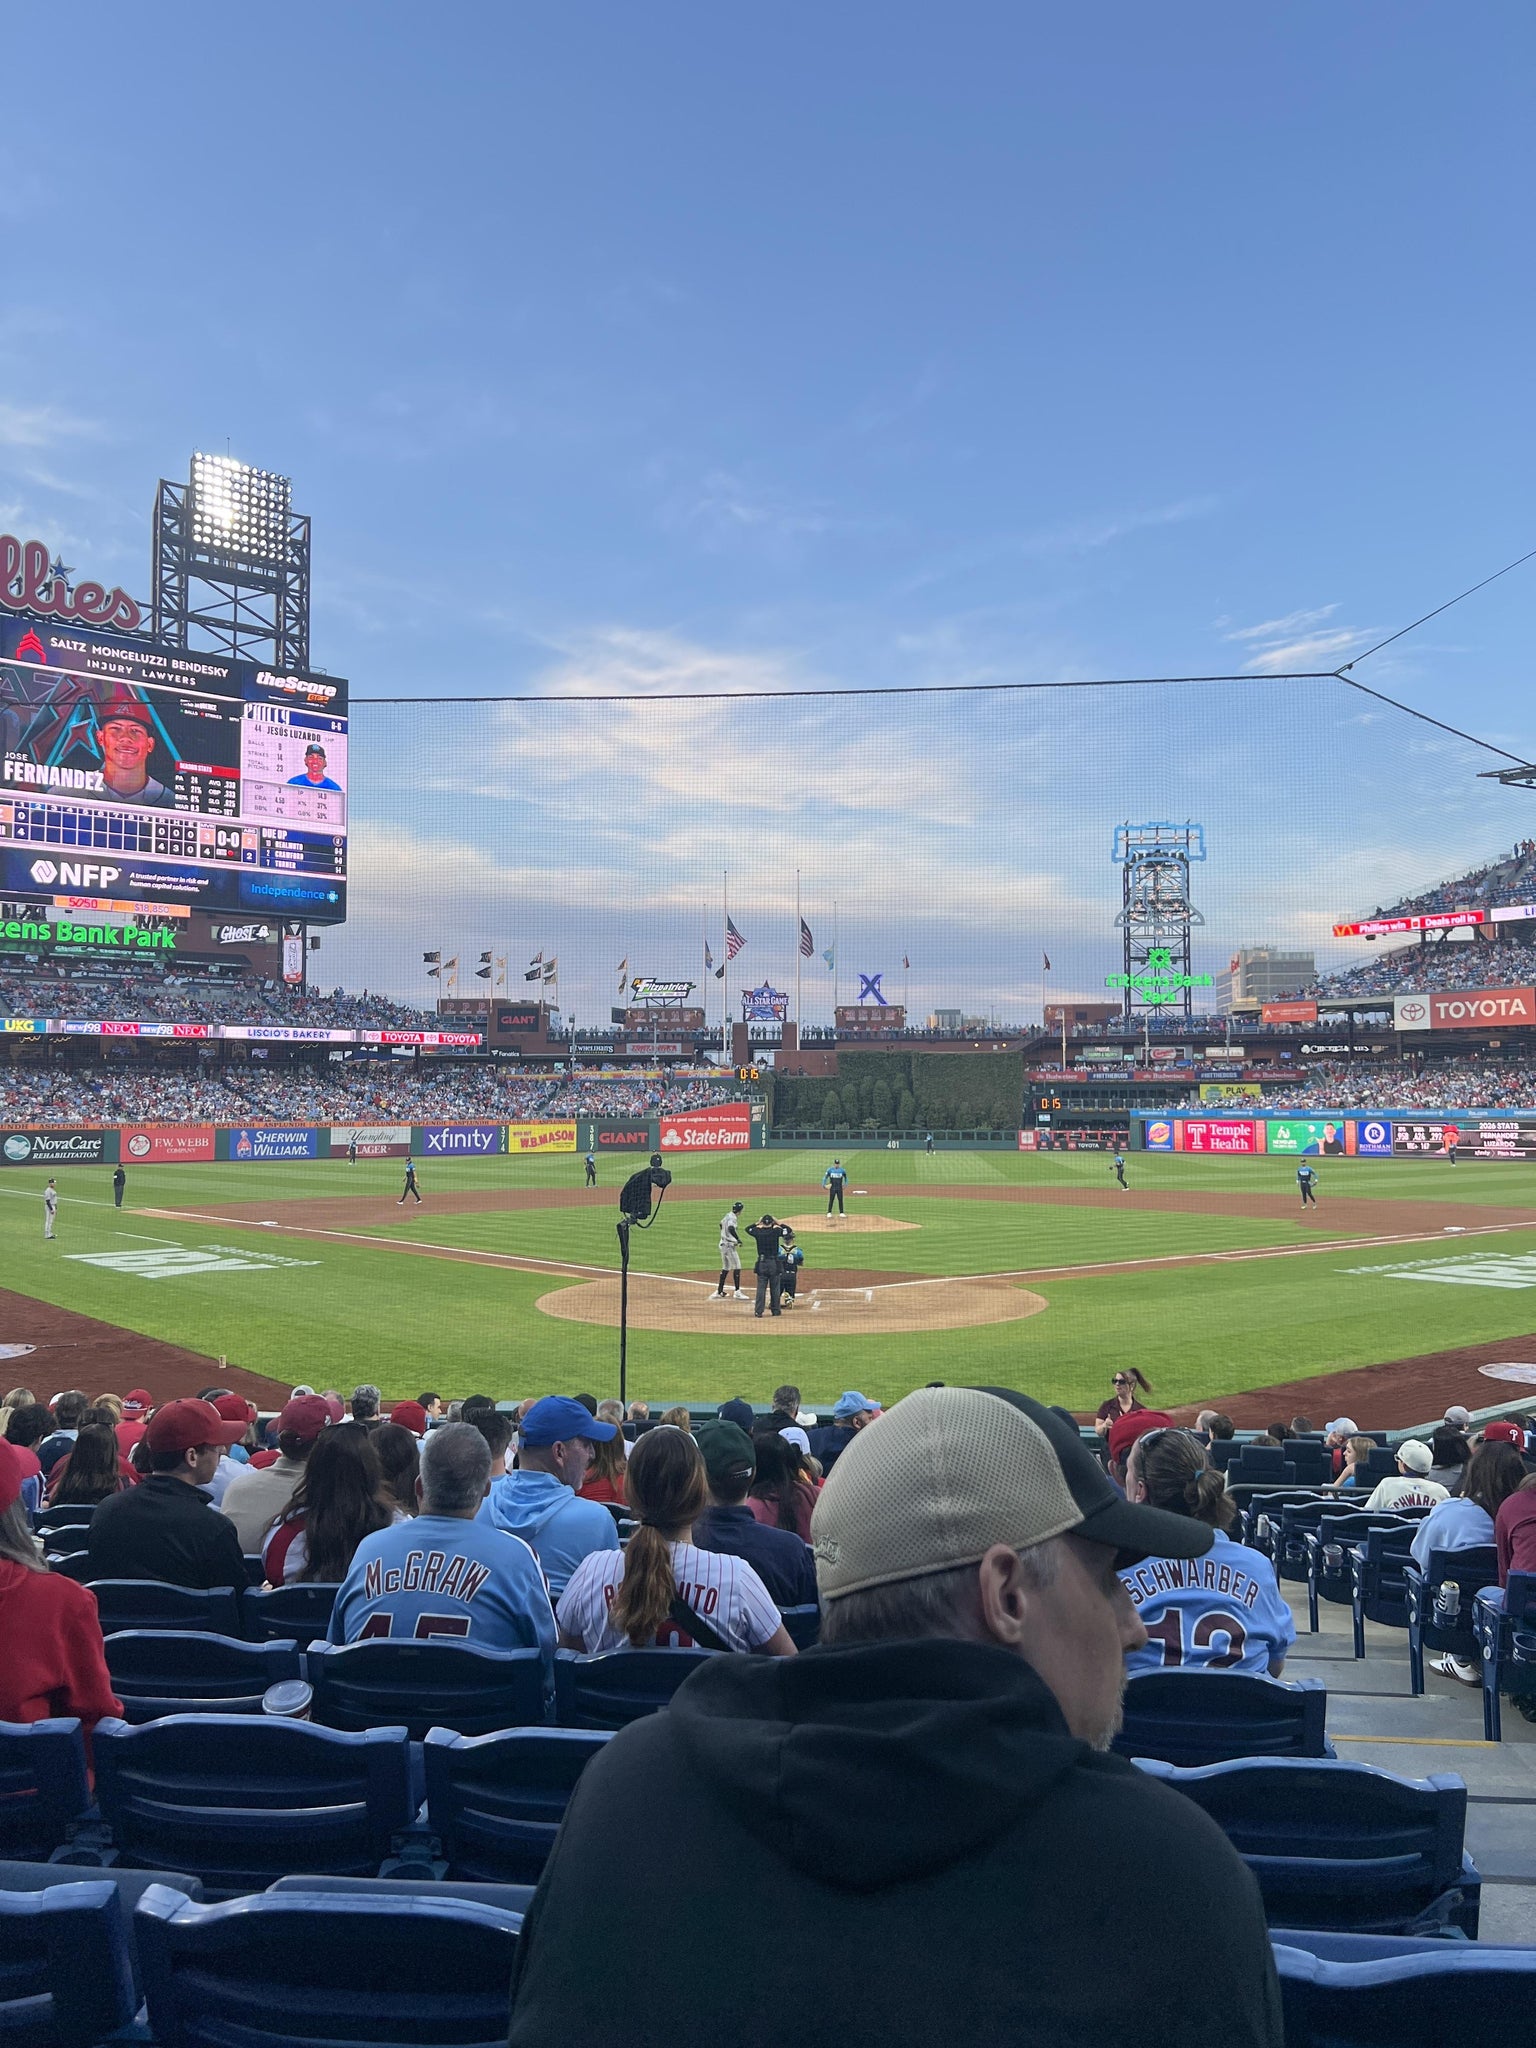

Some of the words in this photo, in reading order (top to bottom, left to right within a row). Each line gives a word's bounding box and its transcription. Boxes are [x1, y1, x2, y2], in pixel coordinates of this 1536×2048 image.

[50, 637, 86, 653] SALTZ
[92, 644, 167, 667] MONGELUZZI
[171, 659, 229, 678] BENDESKY
[86, 659, 133, 675] INJURY
[142, 669, 196, 686] LAWYERS
[256, 671, 337, 697] theScore
[290, 730, 321, 742] LUZARDO
[4, 751, 29, 762] JOSE
[4, 759, 104, 792] FERNANDEZ
[18, 811, 26, 820] 0
[158, 827, 166, 835] 0
[172, 829, 180, 837] 0
[187, 830, 195, 838] 0
[262, 827, 277, 839] DUE
[277, 830, 288, 840] UP
[17, 827, 25, 836] 4
[158, 842, 165, 850] 4
[172, 844, 179, 852] 3
[187, 846, 194, 854] 0
[203, 848, 211, 856] 4
[274, 840, 304, 851] REALMUTO
[274, 850, 304, 861] CRAWFORD
[274, 859, 297, 869] TURNER
[59, 861, 120, 889] NFP
[135, 873, 157, 882] trusted
[156, 875, 179, 884] partner
[185, 876, 197, 885] risk
[129, 880, 152, 888] human
[151, 881, 173, 890] capital
[251, 883, 325, 900] Independence
[1358, 921, 1390, 933] Phillies
[1390, 922, 1407, 930] win
[1425, 916, 1451, 927] Deals
[1451, 914, 1467, 925] roll
[1467, 913, 1476, 923] in
[56, 920, 119, 946] Bank
[123, 925, 177, 949] Park
[220, 924, 260, 944] GHOST
[637, 979, 689, 992] Fitzpatrick
[1105, 973, 1170, 988] Citizens
[1172, 971, 1213, 987] Bank
[754, 996, 771, 1005] STAR
[770, 996, 788, 1005] GAME
[1142, 990, 1177, 1004] Park
[1435, 998, 1527, 1019] TOYOTA
[4, 1019, 35, 1032] UKG
[501, 1015, 536, 1024] GIANT
[104, 1023, 137, 1034] NECA
[175, 1025, 206, 1036] NECA
[247, 1029, 290, 1038] LISCIO'S
[293, 1030, 331, 1040] BAKERY
[385, 1032, 422, 1041] TOYOTA
[442, 1034, 477, 1043] TOYOTA
[1262, 1071, 1297, 1079] Budweiser
[1226, 1086, 1246, 1095] PLAY
[1041, 1098, 1061, 1109] 0:15
[1209, 1123, 1251, 1138] Temple
[1479, 1122, 1497, 1130] 2026
[1497, 1122, 1520, 1130] STATS
[254, 1130, 308, 1143] SHERWIN
[349, 1128, 395, 1143] Yuengling
[428, 1127, 494, 1151] xfinity
[598, 1132, 648, 1144] GIANT
[1371, 1129, 1379, 1137] R
[1479, 1132, 1519, 1140] FERNANDEZ
[32, 1134, 102, 1150] NovaCare
[155, 1138, 176, 1148] F.W.
[177, 1137, 209, 1147] WEBB
[887, 1140, 899, 1149] 401
[1210, 1138, 1249, 1150] Health
[32, 1151, 99, 1159] REHABILITATION
[355, 1144, 388, 1154] LAGER
[364, 1550, 492, 1604] McGRAW
[1120, 1558, 1260, 1609] SCHWARBER
[604, 1581, 719, 1615] RUTO
[1143, 1606, 1248, 1668] 12
